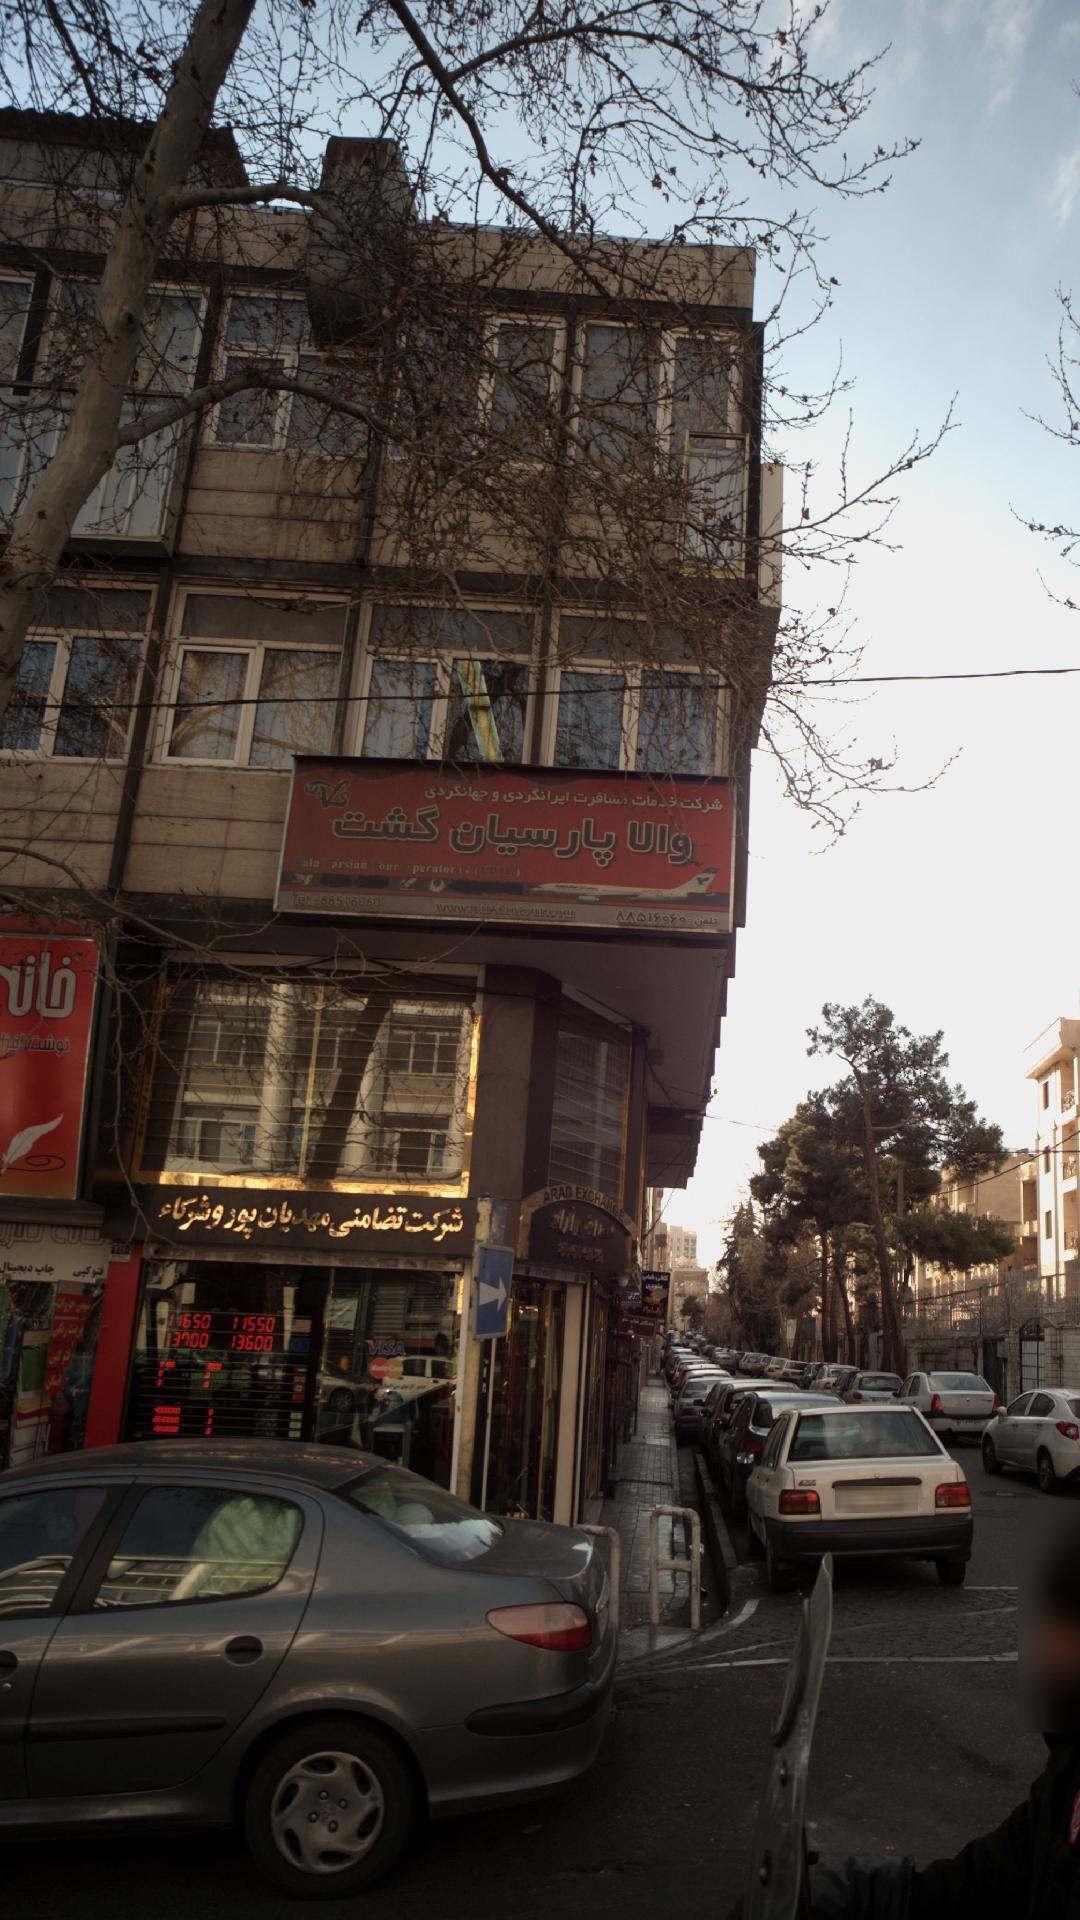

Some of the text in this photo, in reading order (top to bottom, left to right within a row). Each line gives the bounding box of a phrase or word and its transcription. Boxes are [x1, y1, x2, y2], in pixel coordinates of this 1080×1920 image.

[424, 785, 723, 812] شرکت خدمات مسافرت ایرانگردی و جهانگردی
[331, 805, 694, 868] والا پارسیان گشت
[157, 1194, 210, 1231] شرکاء
[257, 1200, 330, 1233] مهدیان
[329, 1204, 407, 1237] تضامنی
[543, 1186, 626, 1222] ARAD EXCHANGE
[222, 1206, 258, 1240] پور
[405, 1206, 465, 1242] شرکت
[168, 1311, 277, 1333] 11650 11550
[165, 1331, 275, 1352] 13700 13600
[368, 1337, 406, 1356] VISA
